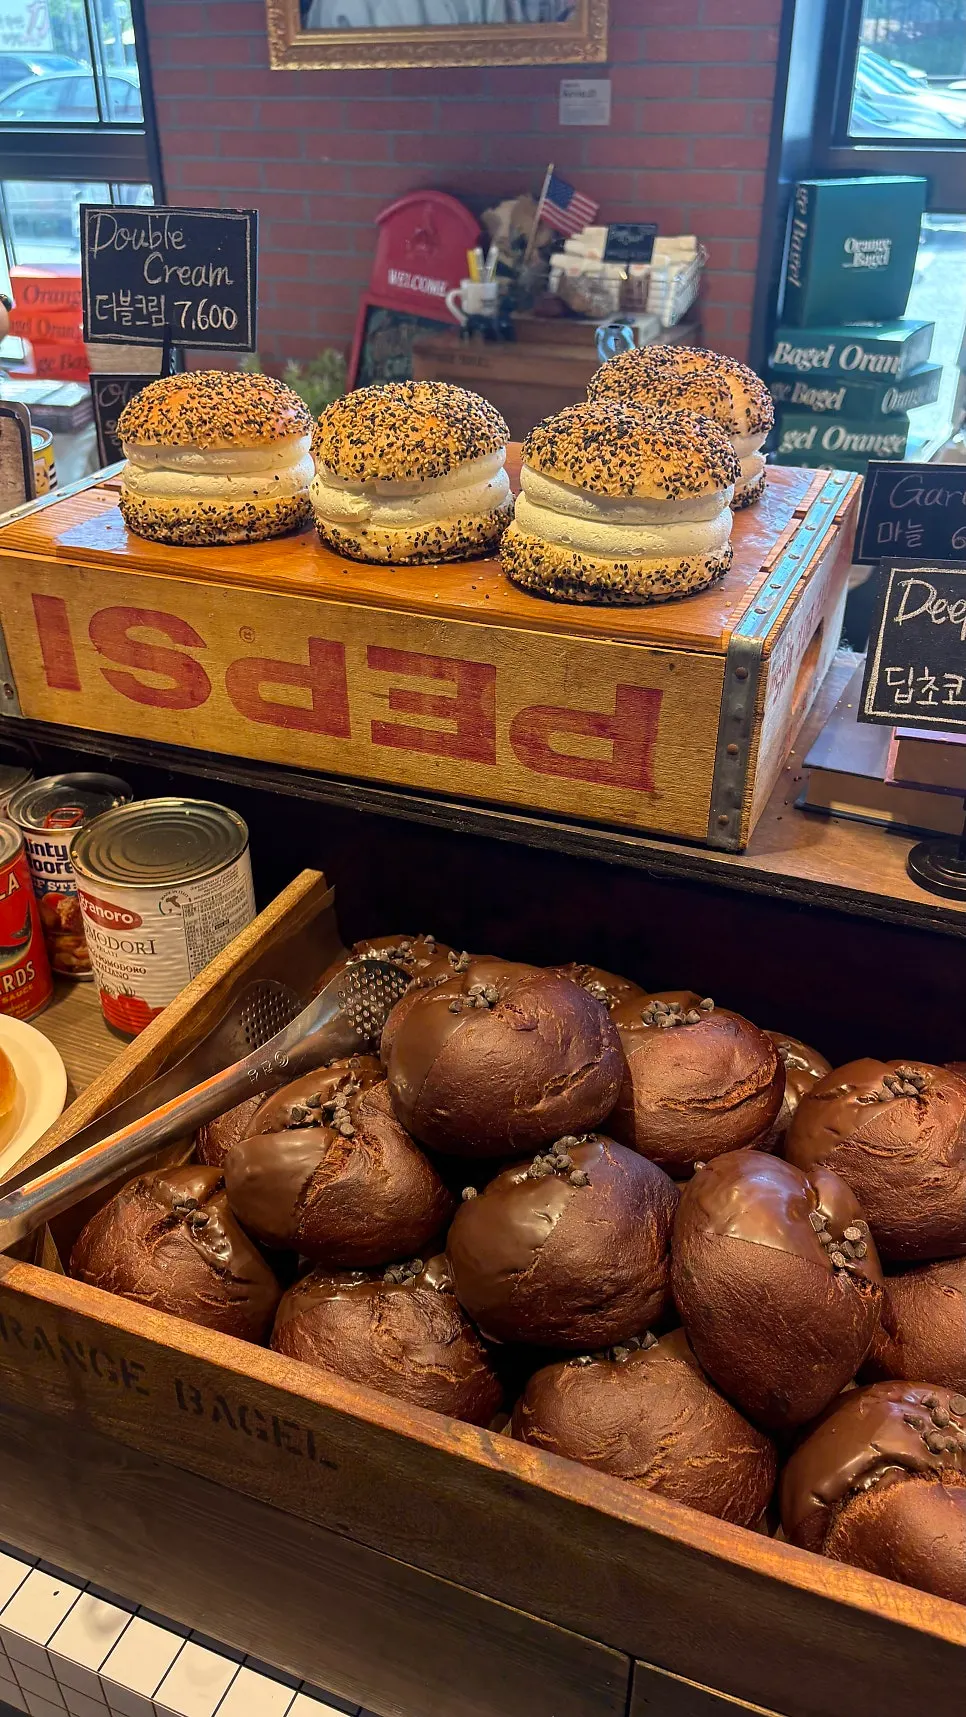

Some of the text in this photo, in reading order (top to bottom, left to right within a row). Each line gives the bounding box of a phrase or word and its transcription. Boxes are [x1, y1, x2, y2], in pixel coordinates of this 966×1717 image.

[88, 212, 187, 259] Double
[843, 237, 892, 254] Orange
[143, 251, 235, 287] Cream
[787, 219, 807, 288] Bagel
[387, 268, 447, 298] WELCOME
[95, 288, 239, 331] 더블크림 7,600
[772, 340, 836, 372] Bagel
[791, 381, 846, 412] Bagel
[778, 425, 906, 457] gel Orange
[890, 474, 966, 508] Gar
[878, 519, 924, 548] 마늘
[31, 592, 663, 798] PEPSI
[884, 666, 966, 706] 딥초코
[174, 1376, 338, 1471] BAGEL
